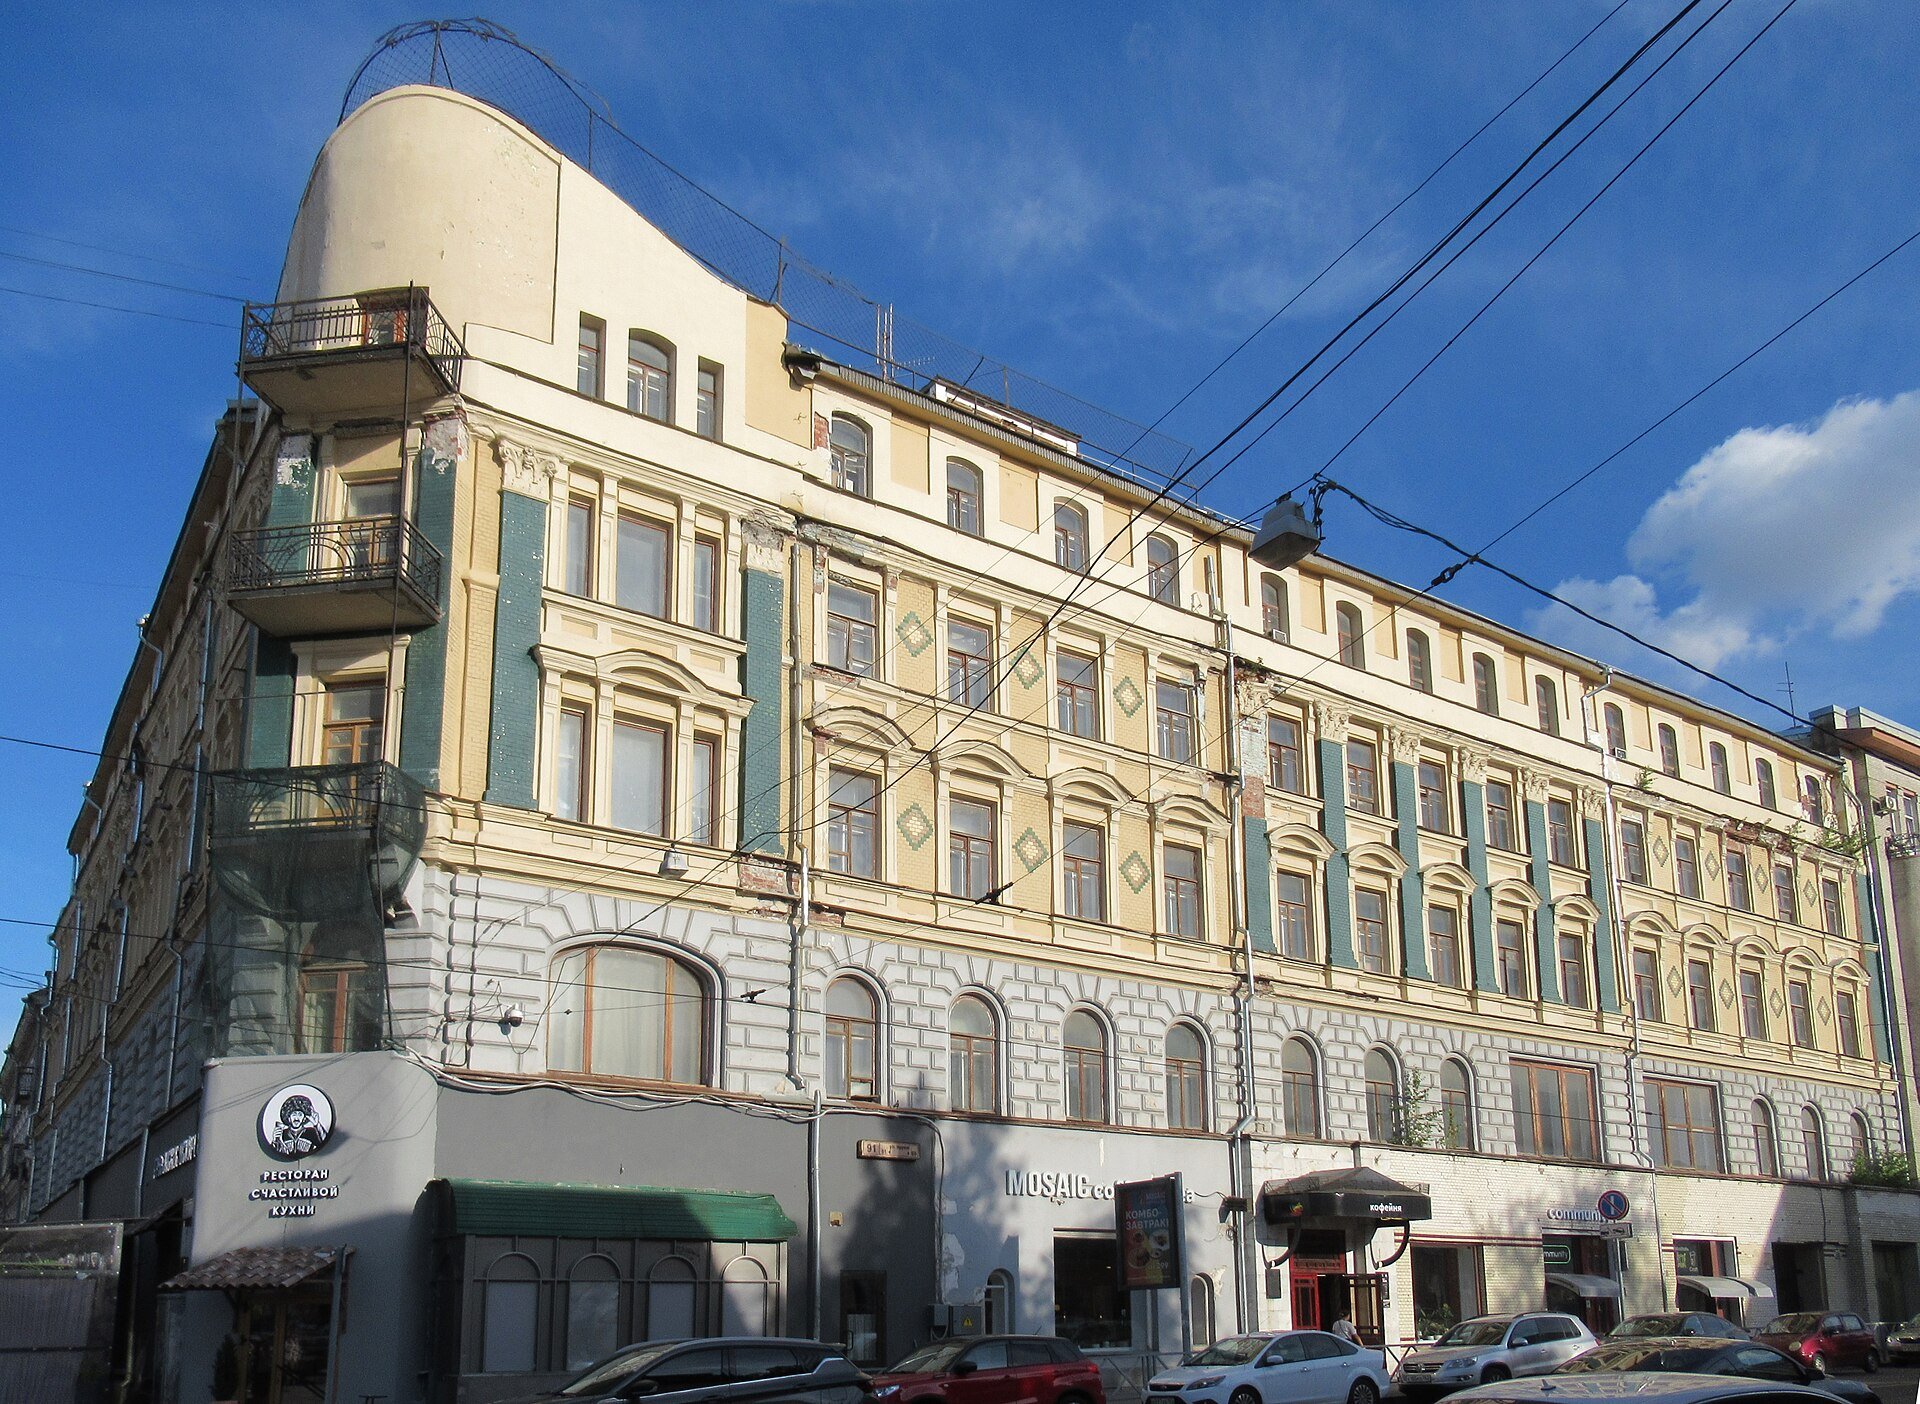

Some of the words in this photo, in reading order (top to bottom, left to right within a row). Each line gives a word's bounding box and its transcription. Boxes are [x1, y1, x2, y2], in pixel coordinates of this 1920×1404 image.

[866, 1143, 877, 1153] 91
[262, 1169, 329, 1181] РЕСТОРАН
[1006, 1169, 1090, 1199] MOSAIC
[251, 1185, 339, 1199] СЧАСТЛИВОЙ
[272, 1205, 316, 1216] КУХНИ
[1369, 1202, 1402, 1214] кофейня
[1547, 1208, 1611, 1223] communi
